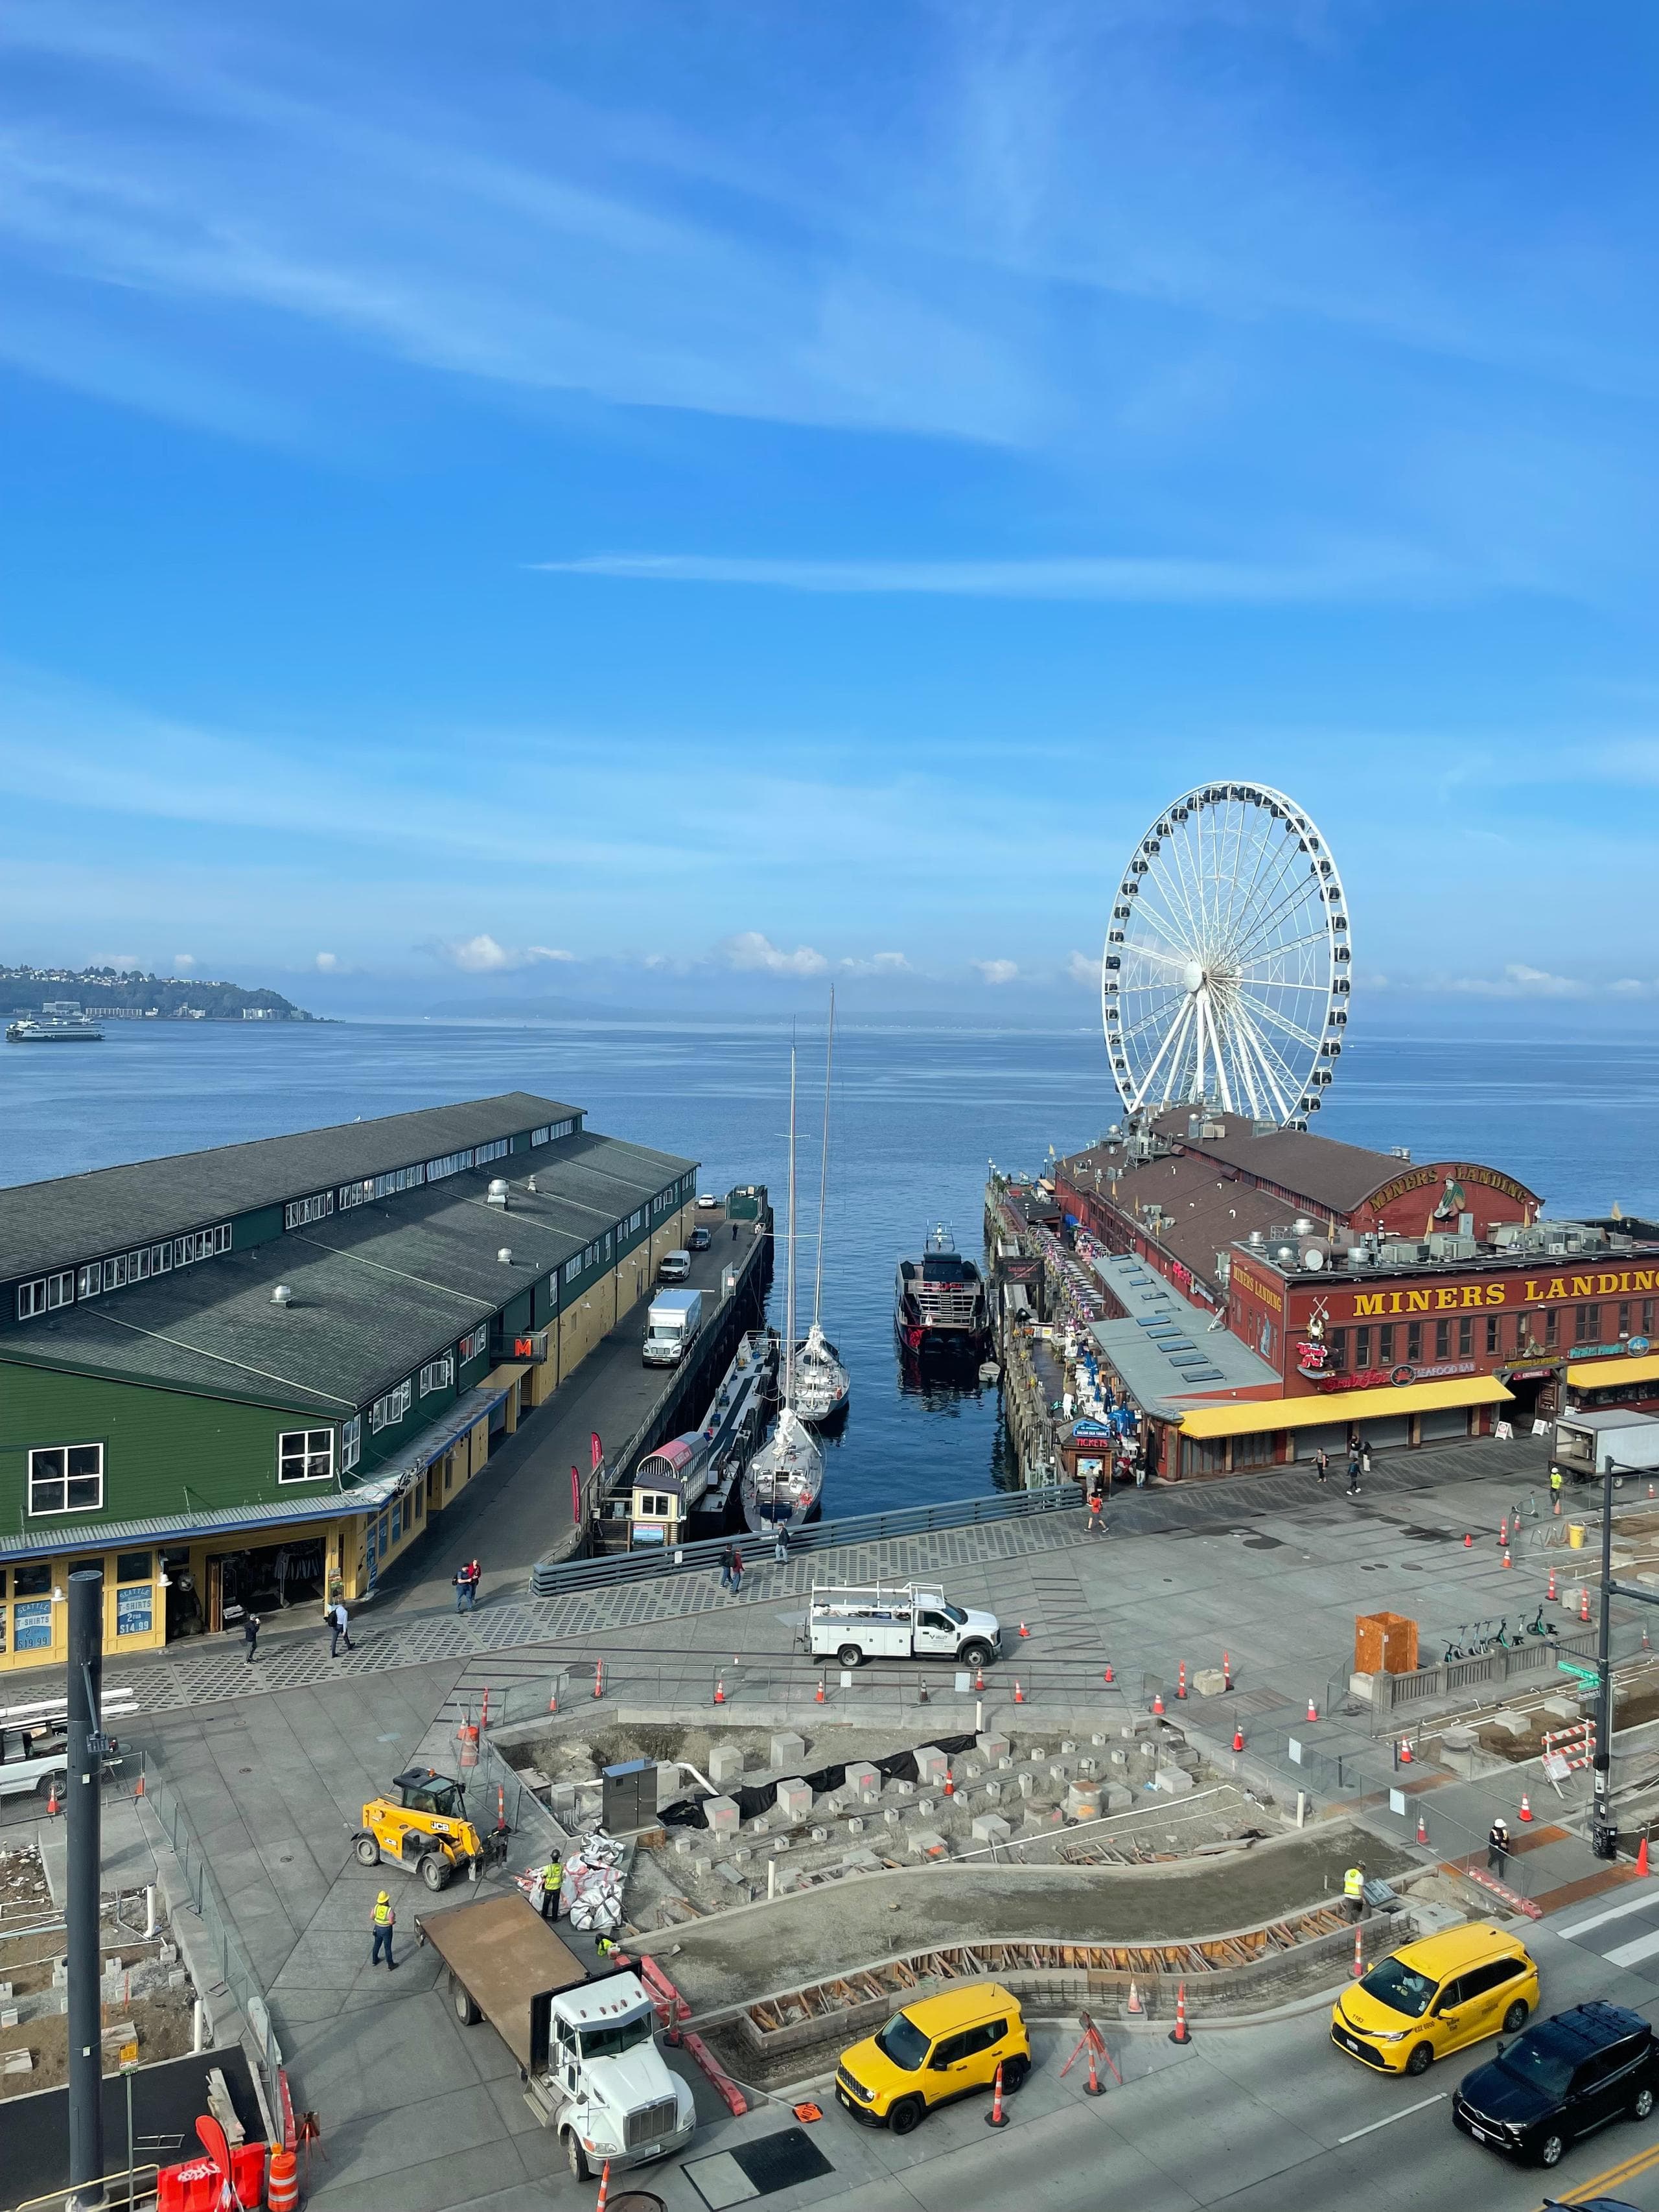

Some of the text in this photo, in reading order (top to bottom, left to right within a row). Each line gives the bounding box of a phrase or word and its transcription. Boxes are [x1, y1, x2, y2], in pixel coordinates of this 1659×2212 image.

[1369, 1166, 1527, 1213] MINERS LANDING
[1233, 1265, 1282, 1312] MINERS LANDING
[1352, 1269, 1659, 1317] MINERS LANDIN
[515, 1338, 531, 1356] M
[1415, 1364, 1457, 1379] SEAFOOD
[1076, 1438, 1108, 1447] TICKETS
[119, 1588, 150, 1600] SEATTLE
[17, 1603, 49, 1614] SEATTLE
[118, 1600, 151, 1613] T-SHIRTS
[17, 1616, 49, 1627] T-SHIRTS
[127, 1613, 133, 1622] 2
[25, 1629, 30, 1637] 2
[119, 1621, 149, 1634] $14.99
[18, 1636, 47, 1650] $19.99
[431, 1821, 449, 1832] JCB
[384, 1837, 397, 1846] JCB
